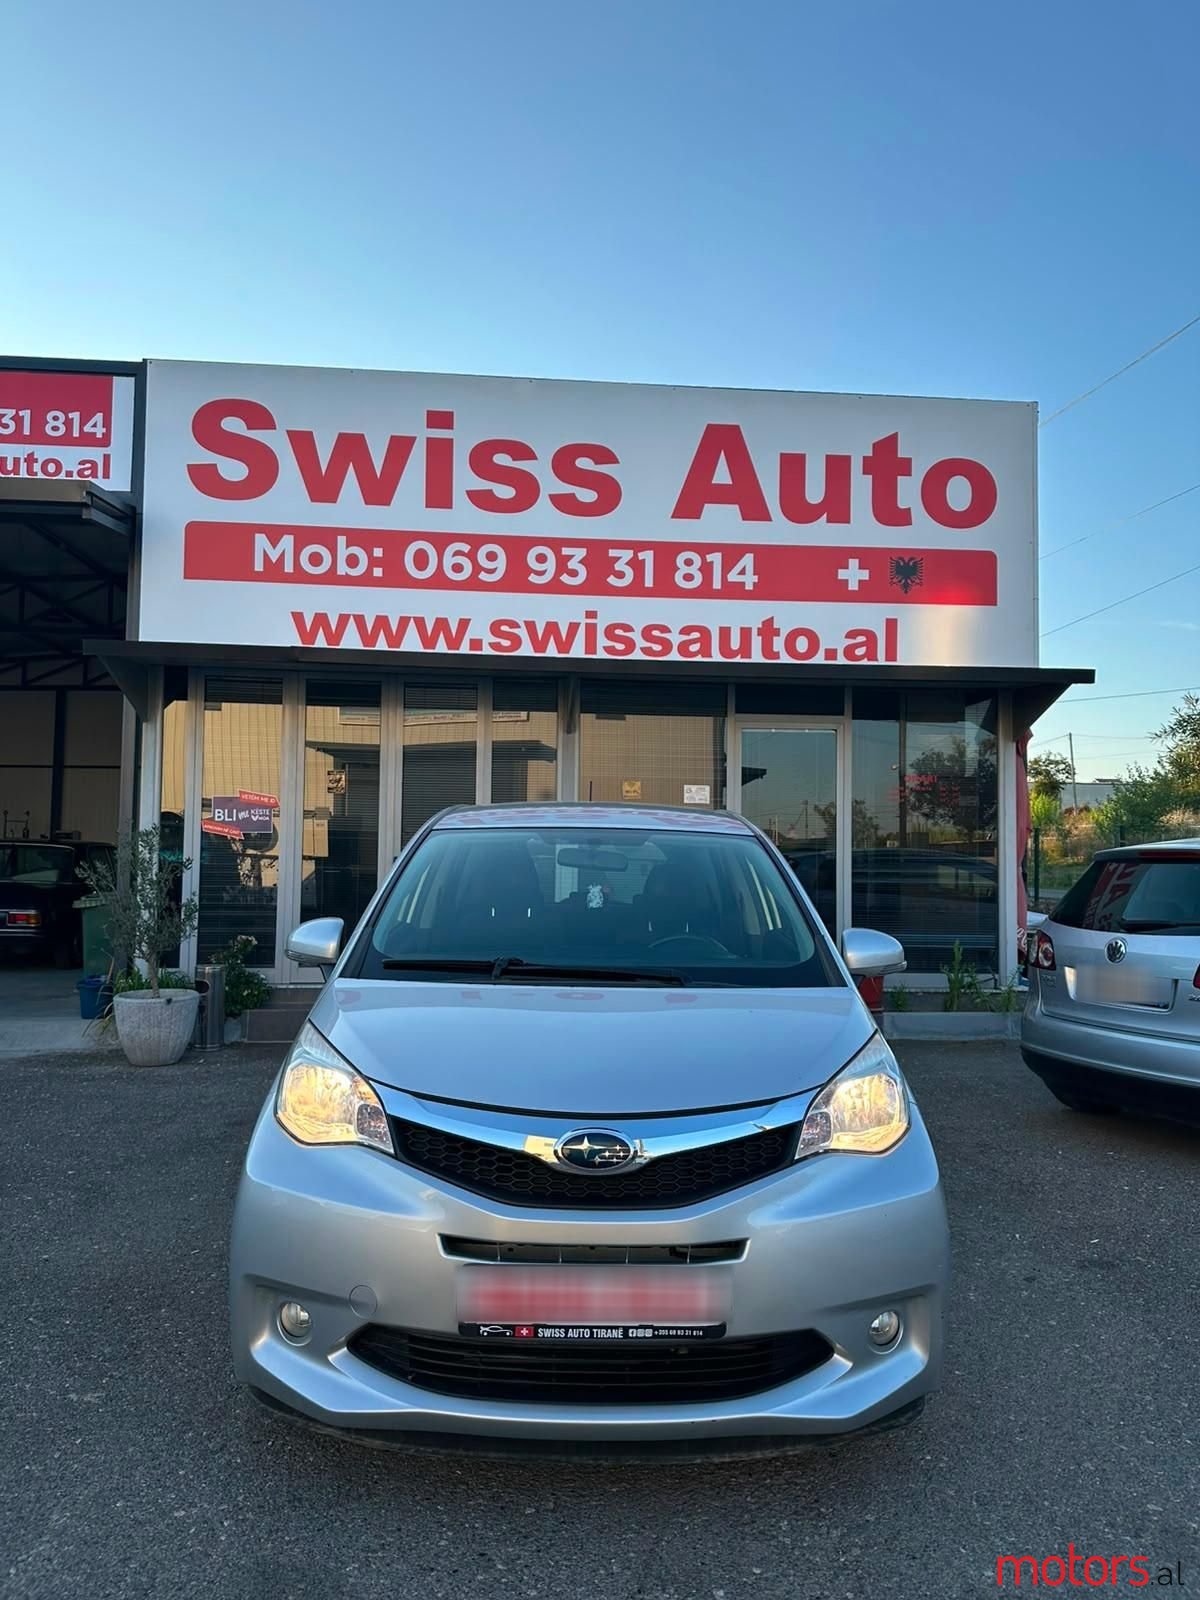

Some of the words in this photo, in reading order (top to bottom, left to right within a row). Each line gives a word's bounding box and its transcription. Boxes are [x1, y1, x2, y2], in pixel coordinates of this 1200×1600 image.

[0, 408, 31, 435] 31
[45, 410, 107, 438] 814
[0, 451, 111, 480] uto.al
[187, 399, 622, 518] Swiss
[671, 423, 997, 530] Auto
[253, 533, 384, 578] Mob:
[404, 540, 507, 582] 069
[526, 546, 588, 586] 93
[606, 549, 654, 588] 31
[674, 552, 759, 590] 814
[291, 610, 898, 663] www.swissauto.al
[215, 808, 237, 821] BLI
[537, 1328, 566, 1338] SWISS
[567, 1328, 591, 1338] AUTO
[592, 1327, 624, 1339] TIRANË
